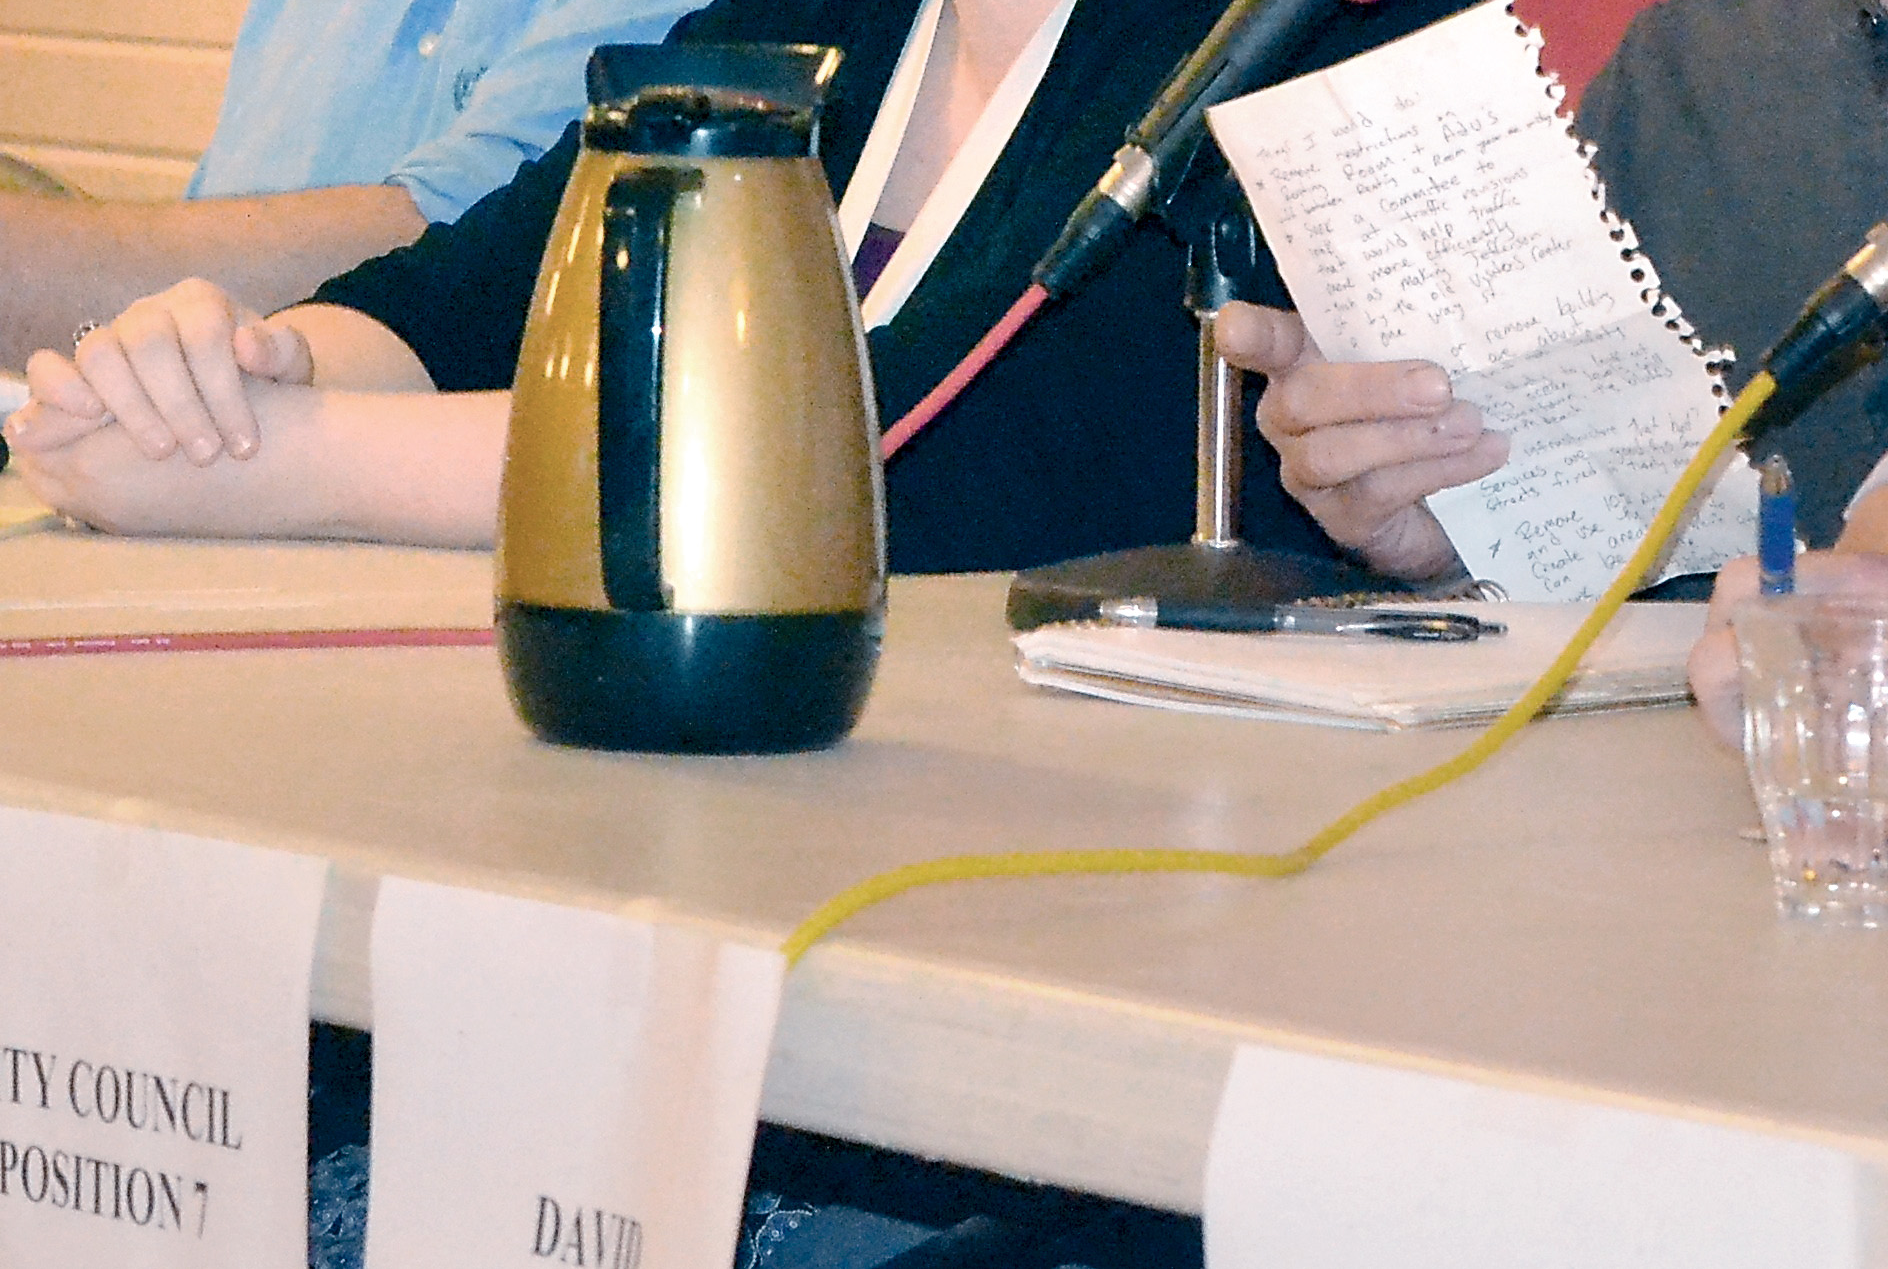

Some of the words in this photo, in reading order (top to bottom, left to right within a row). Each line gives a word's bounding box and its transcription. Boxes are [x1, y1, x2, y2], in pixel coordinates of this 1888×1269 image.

[3, 1047, 56, 1109] TY
[69, 1058, 242, 1150] COUNCIL
[0, 1140, 183, 1232] POSITION
[193, 1180, 209, 1239] 7
[530, 1195, 643, 1269] DAVID
